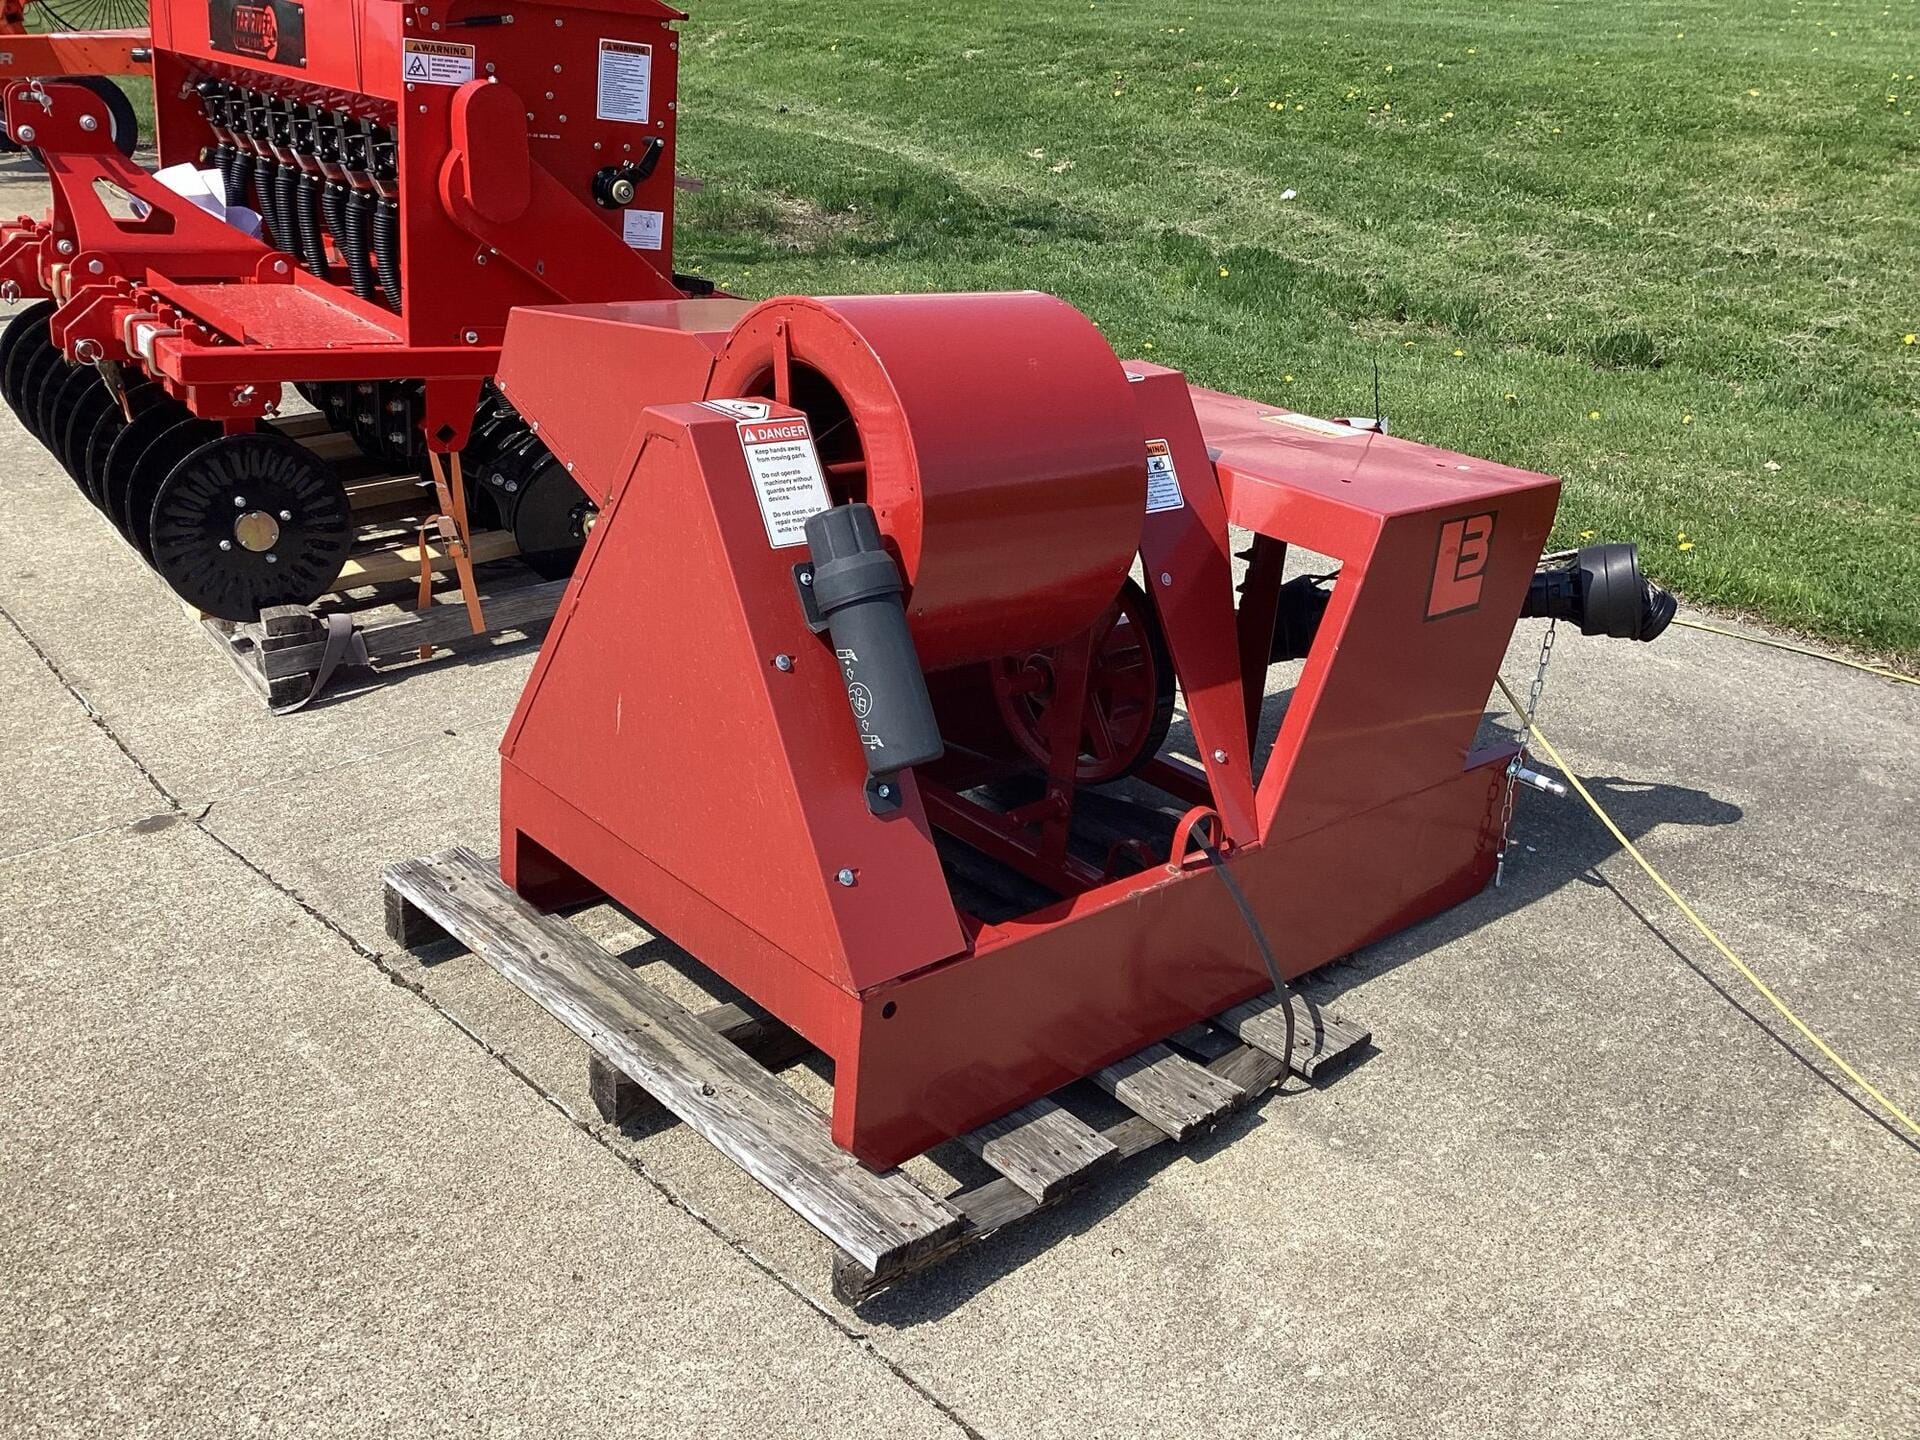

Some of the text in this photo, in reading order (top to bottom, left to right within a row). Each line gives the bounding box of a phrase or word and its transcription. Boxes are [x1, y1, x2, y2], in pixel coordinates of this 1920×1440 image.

[421, 43, 467, 56] WARNING
[757, 425, 807, 440] DANGER
[780, 469, 801, 477] operate
[766, 487, 785, 495] guards
